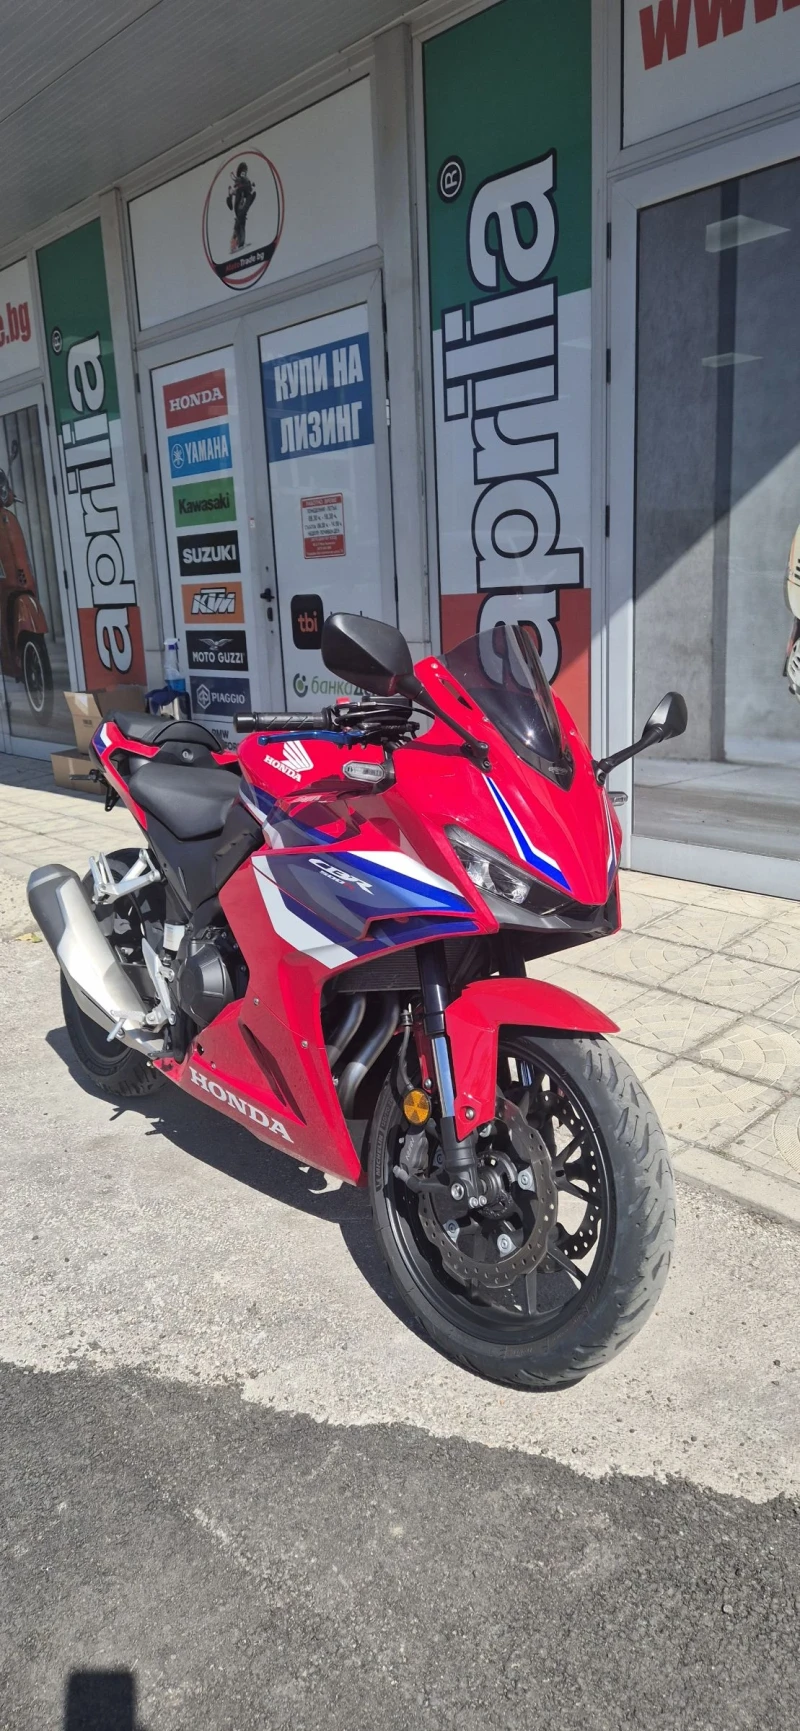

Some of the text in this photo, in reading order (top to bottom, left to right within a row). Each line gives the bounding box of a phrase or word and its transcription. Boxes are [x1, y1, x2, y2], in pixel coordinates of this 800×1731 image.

[274, 343, 364, 402] КУПИ НА
[169, 387, 224, 412] HONDA
[280, 401, 363, 454] ЛИЗИНГ
[441, 147, 585, 693] aprilia
[184, 434, 229, 464] YAMAHA
[61, 330, 138, 675] aprilia
[178, 492, 230, 515] Kawasaki
[182, 544, 237, 564] SUZUKI
[191, 587, 236, 614] KTM
[297, 611, 318, 633] tbi
[192, 651, 243, 664] MOTO GUZZI
[211, 692, 245, 704] PIAGGIO
[263, 754, 302, 783] HONDA
[308, 858, 375, 896] CBR
[189, 1066, 295, 1144] HONDA
[375, 1134, 384, 1177] MICHELIN
